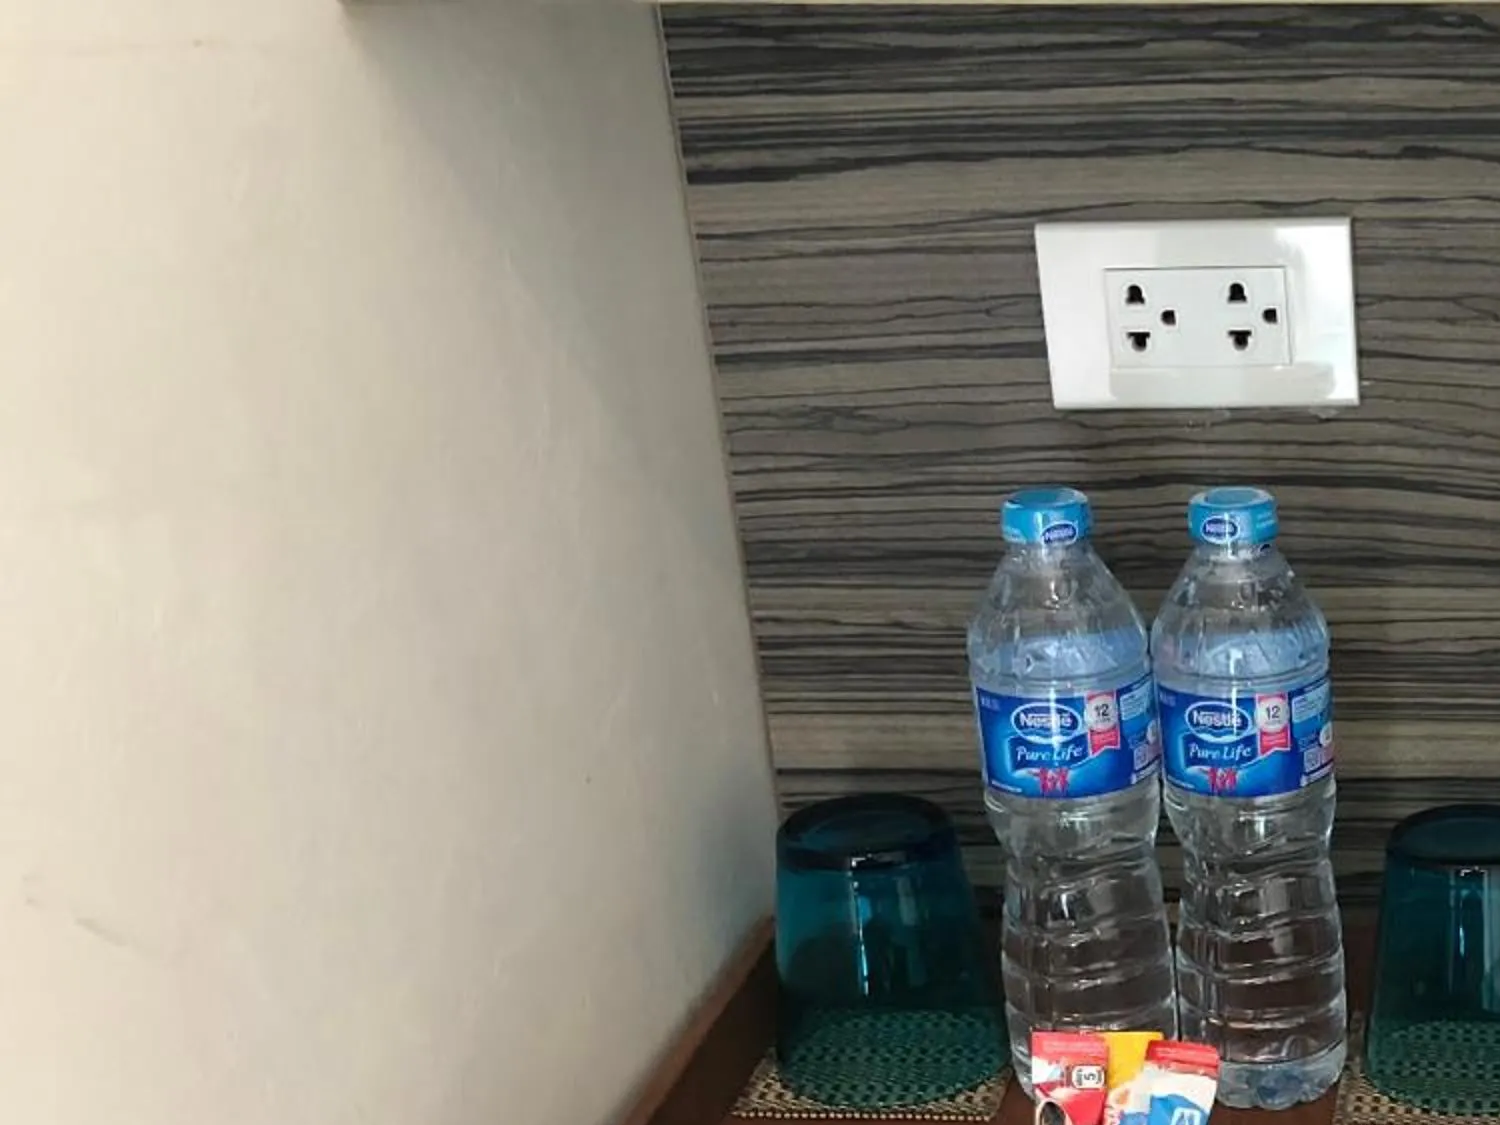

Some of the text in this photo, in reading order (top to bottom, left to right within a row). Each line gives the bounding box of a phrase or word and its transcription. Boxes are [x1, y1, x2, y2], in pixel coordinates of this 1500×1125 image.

[1094, 703, 1109, 717] 12
[1266, 705, 1280, 720] 12
[1020, 711, 1073, 728] Nesé
[1015, 744, 1083, 761] Pure Life
[1188, 742, 1252, 761] Pure Life
